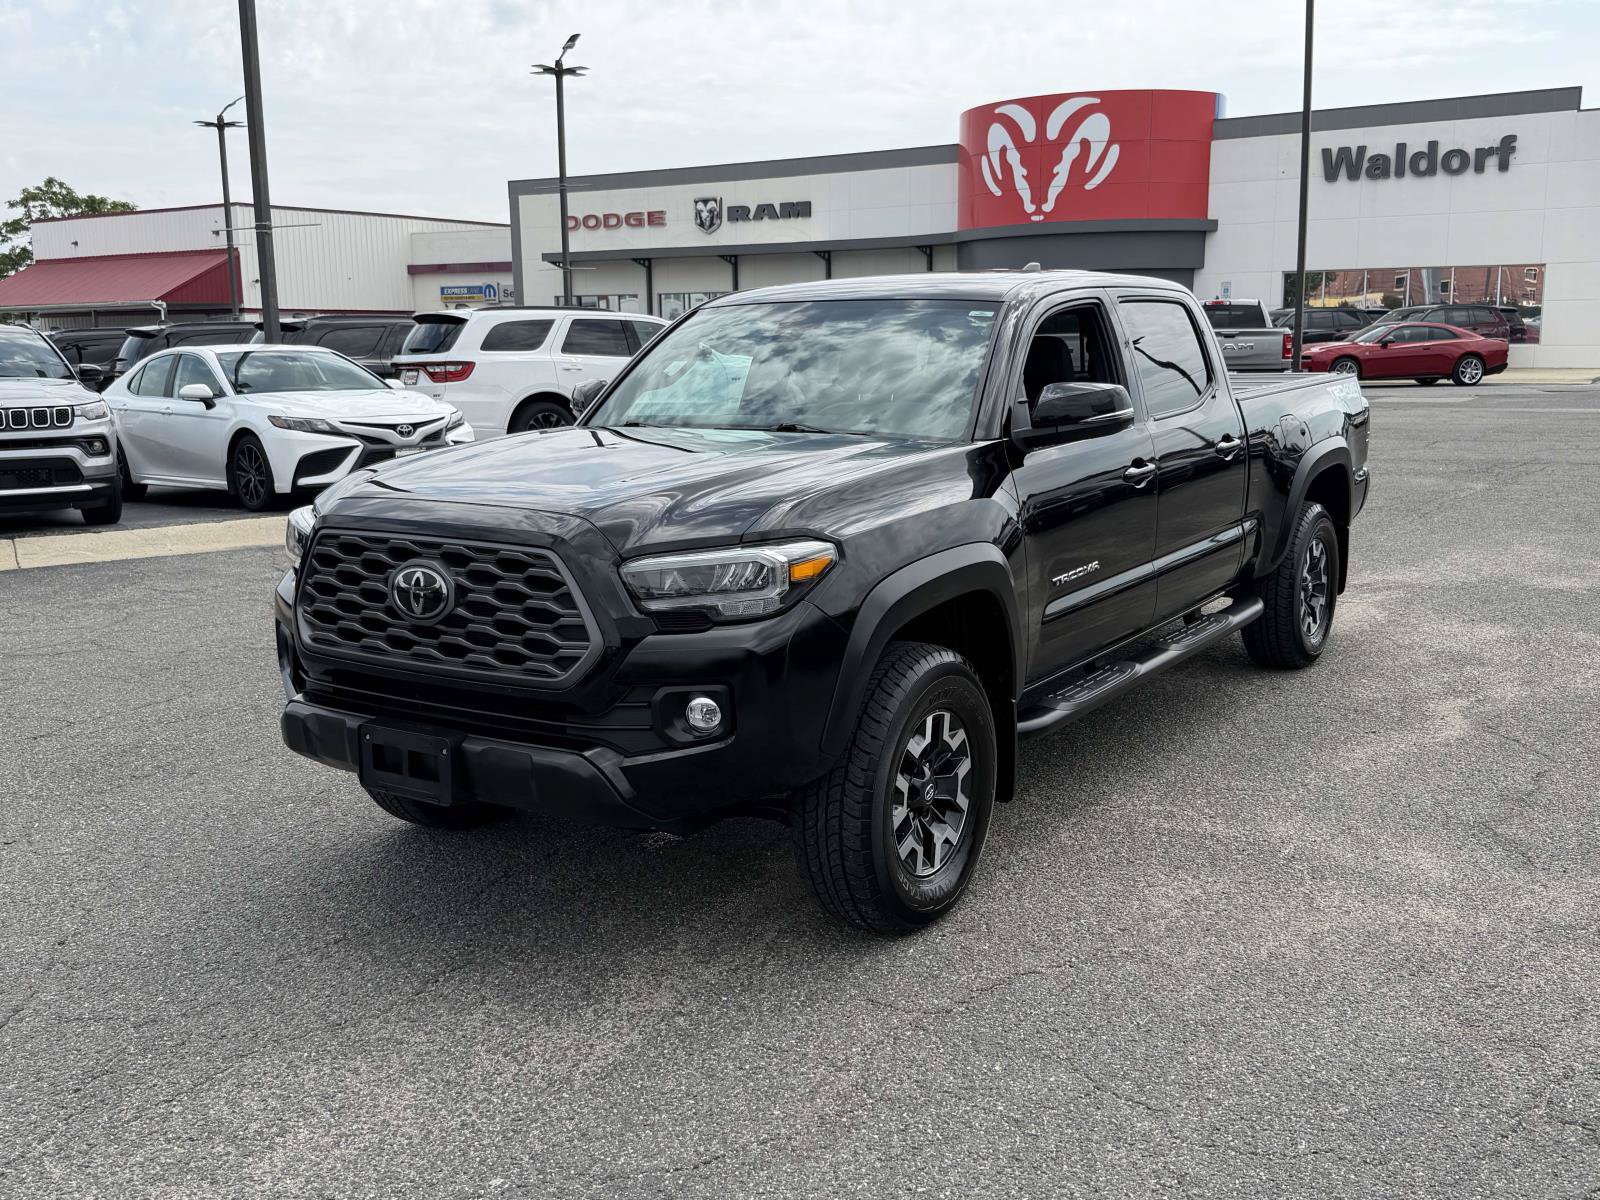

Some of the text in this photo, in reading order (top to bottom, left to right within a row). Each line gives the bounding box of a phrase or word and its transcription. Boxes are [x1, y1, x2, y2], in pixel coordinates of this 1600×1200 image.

[1321, 134, 1518, 183] Waldorf
[567, 210, 667, 232] DODGE
[727, 200, 812, 222] RAM
[444, 287, 468, 295] EXPRESS
[1222, 343, 1255, 351] AM
[1051, 560, 1101, 586] TACOMA
